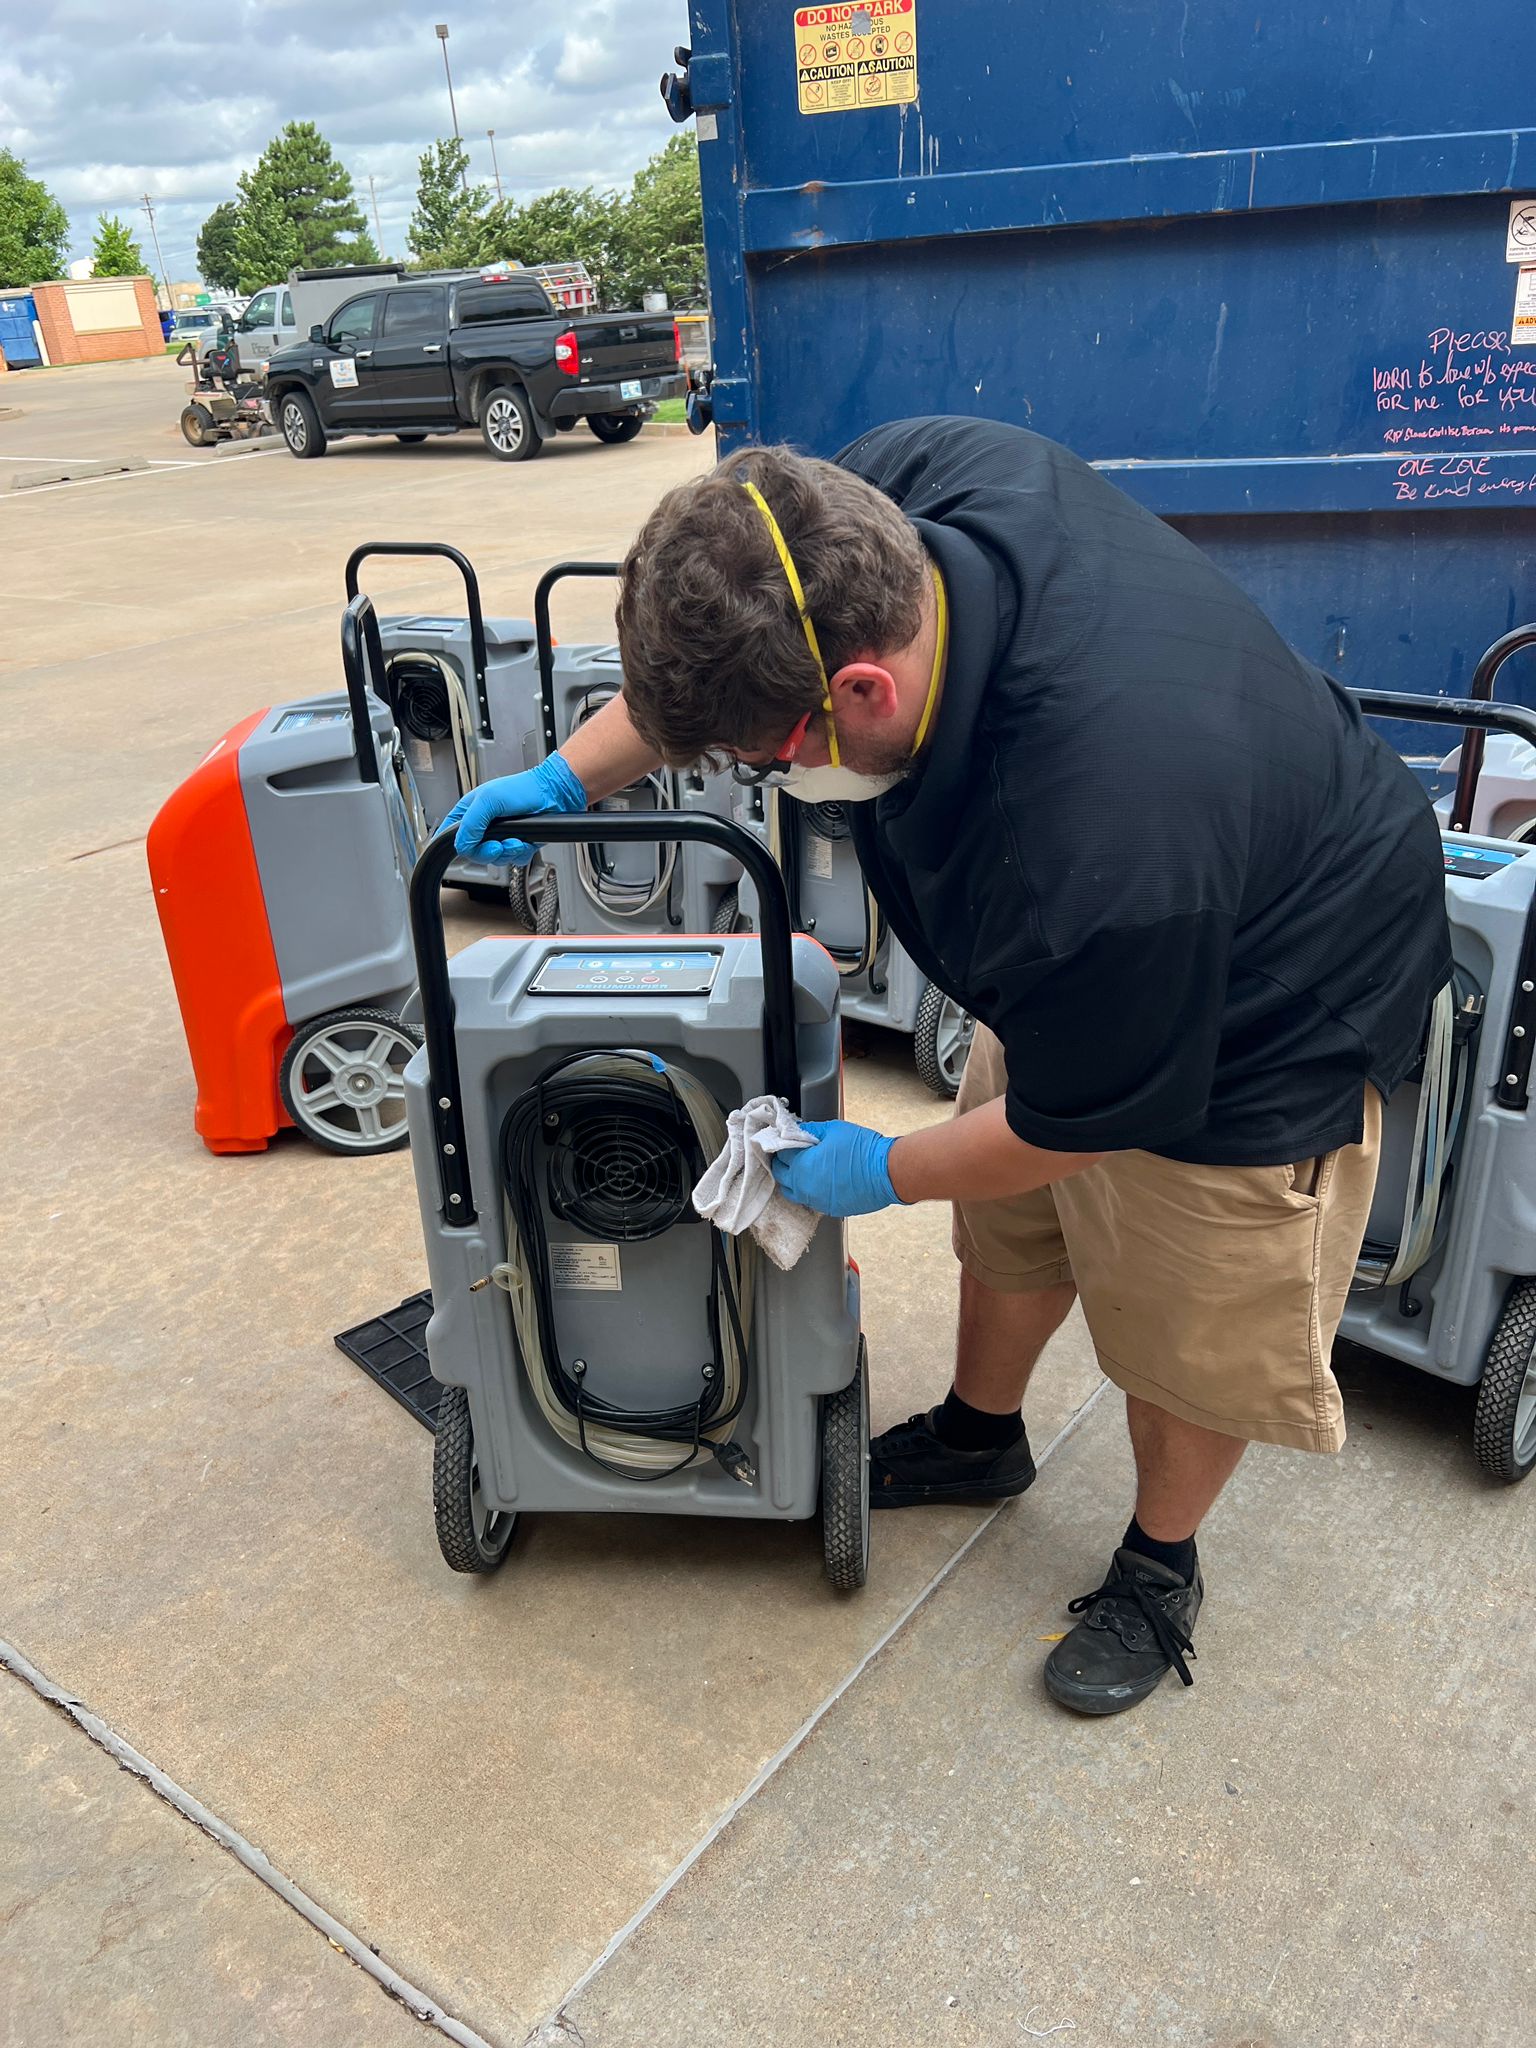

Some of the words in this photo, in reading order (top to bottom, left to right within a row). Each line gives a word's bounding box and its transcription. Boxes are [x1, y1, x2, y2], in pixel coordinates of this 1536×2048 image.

[807, 10, 827, 25] DO
[864, 0, 904, 17] PARK
[820, 31, 850, 41] WASTES
[826, 24, 837, 32] NO
[810, 63, 854, 81] CAUTION
[869, 56, 913, 73] CAUTION
[1418, 359, 1434, 388] to
[1398, 457, 1435, 477] ONE
[1439, 456, 1492, 475] LOVE
[1392, 481, 1418, 500] Be
[576, 983, 670, 991] DEHUMIDIFIER
